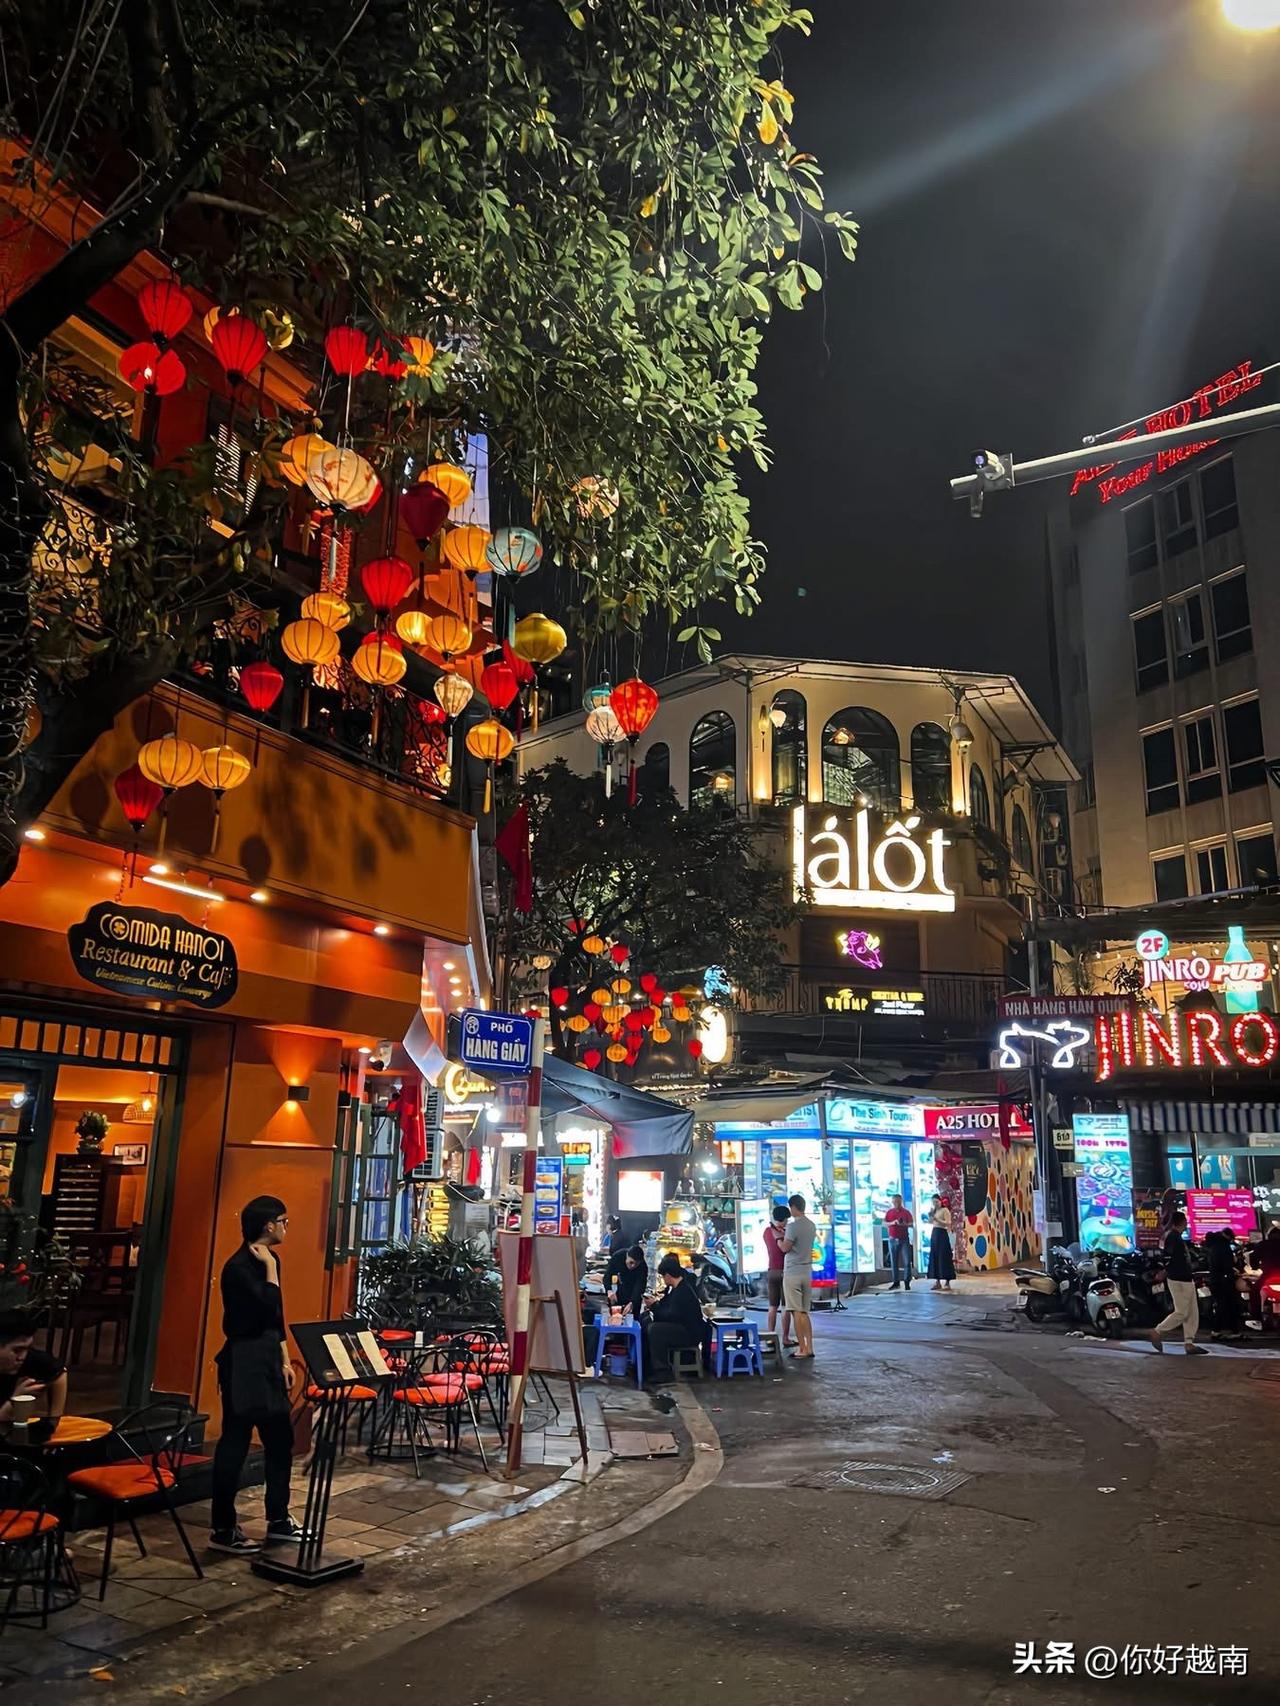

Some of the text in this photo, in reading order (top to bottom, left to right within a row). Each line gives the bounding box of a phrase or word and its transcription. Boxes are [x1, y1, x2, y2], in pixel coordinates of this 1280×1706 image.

[101, 914, 225, 962] COMIDA HANOI
[1141, 938, 1164, 953] 2F
[80, 937, 175, 976] Restaurant
[178, 959, 195, 981] &
[1143, 957, 1210, 989] JINRO
[1213, 963, 1267, 982] PUB
[490, 1020, 514, 1034] PHỐ
[466, 1034, 527, 1063] HÀNG GIẤY
[1095, 1011, 1279, 1083] JINRO
[936, 1112, 1021, 1130] A25 HOTL
